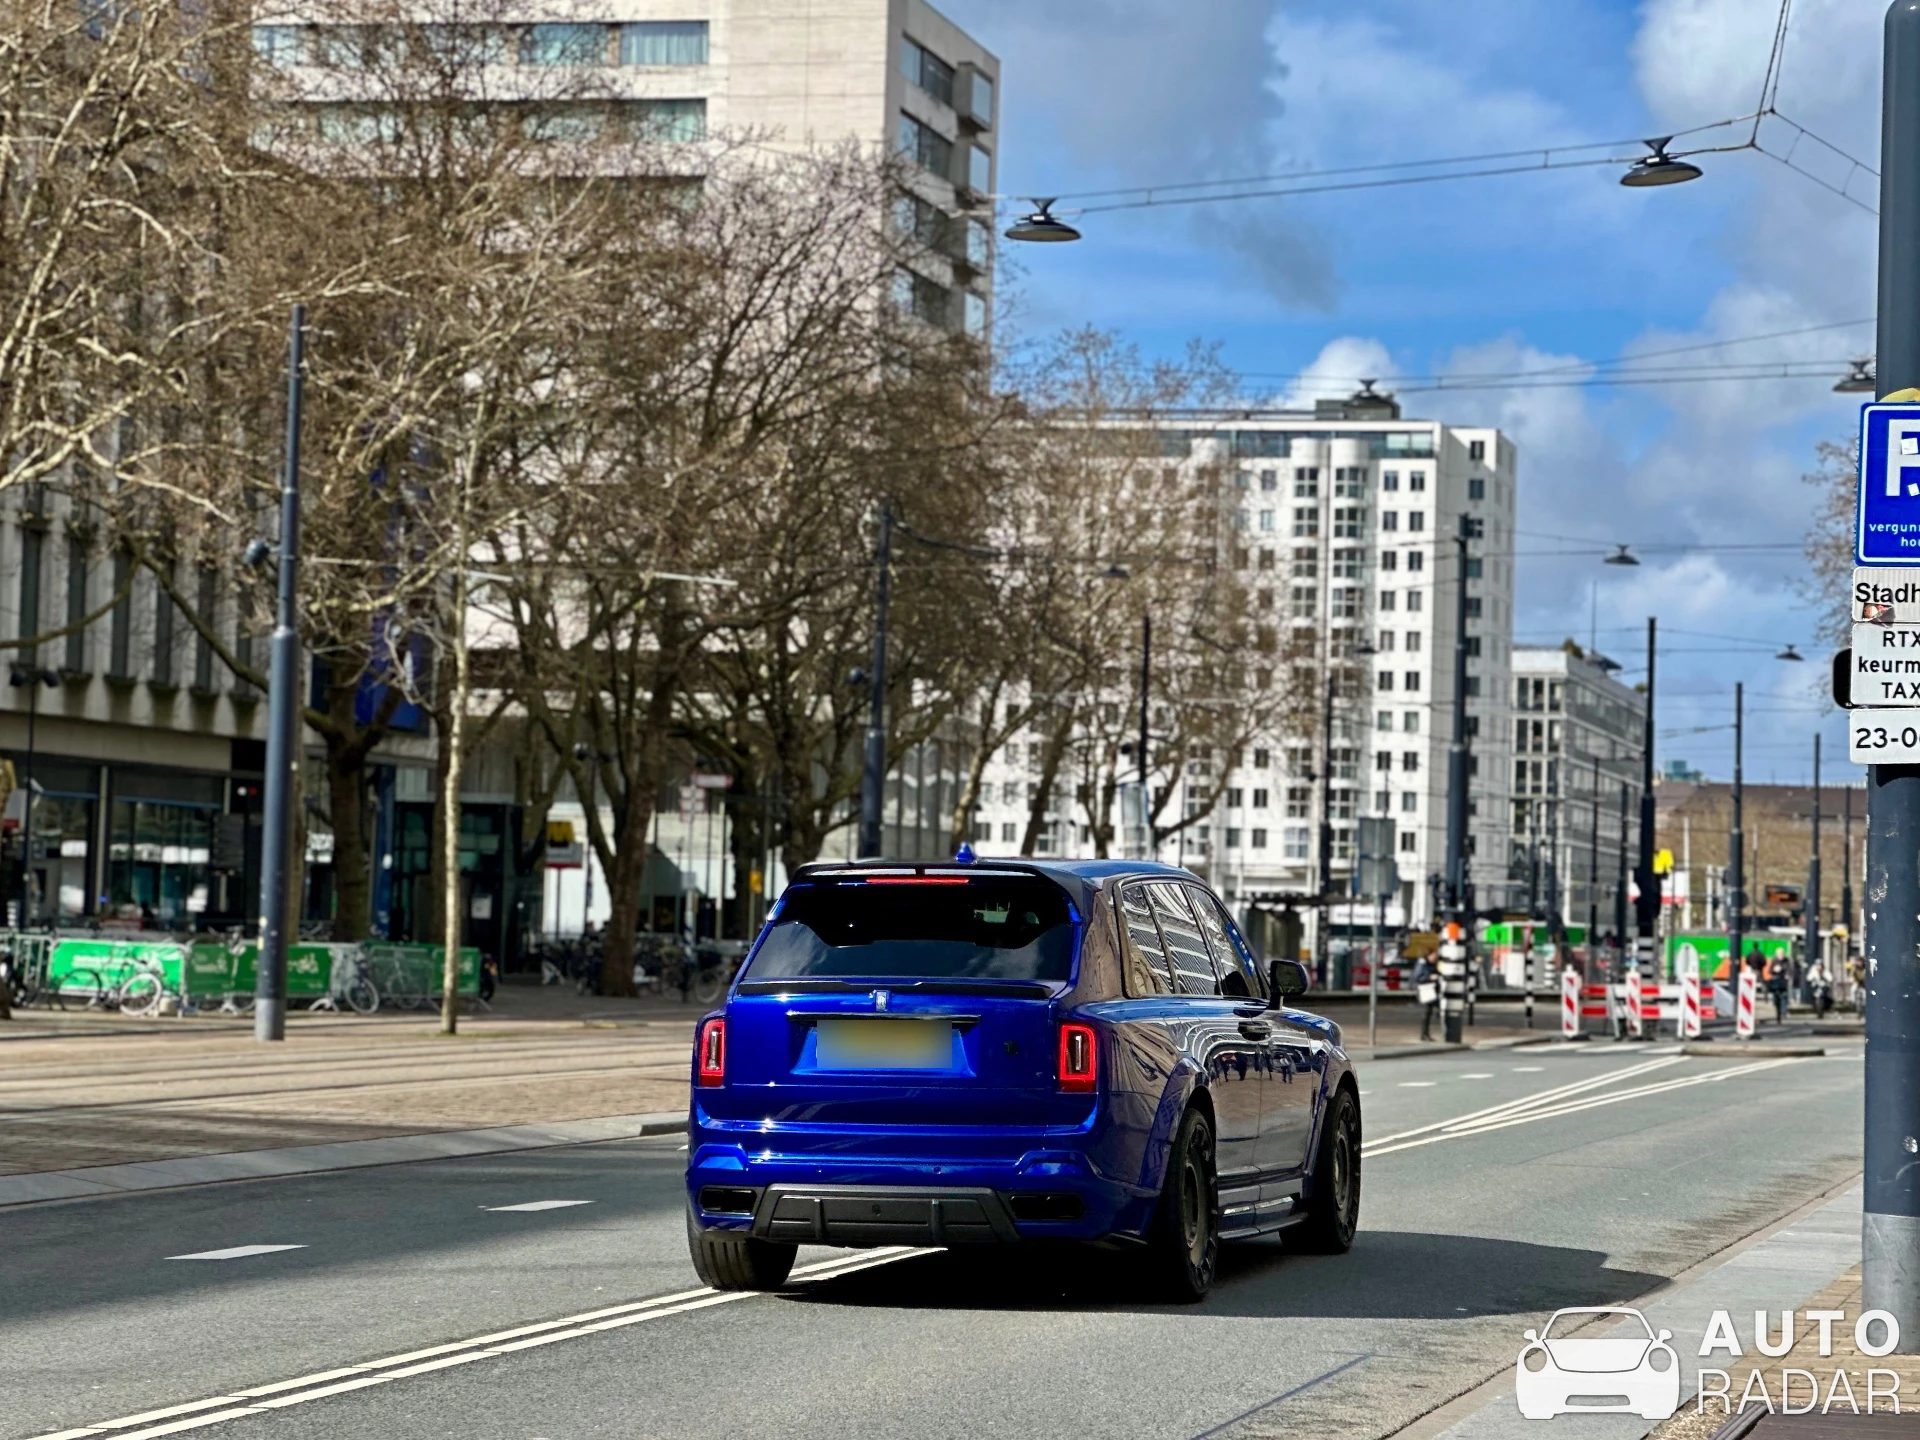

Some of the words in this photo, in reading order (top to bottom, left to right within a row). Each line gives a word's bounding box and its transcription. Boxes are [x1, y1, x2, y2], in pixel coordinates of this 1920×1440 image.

[1869, 523, 1920, 535] vergun
[1855, 582, 1920, 603] Stadh
[1882, 630, 1920, 648] RTX
[1858, 655, 1920, 674] keurm
[1881, 682, 1920, 699] TAX
[1855, 727, 1920, 748] 23-0
